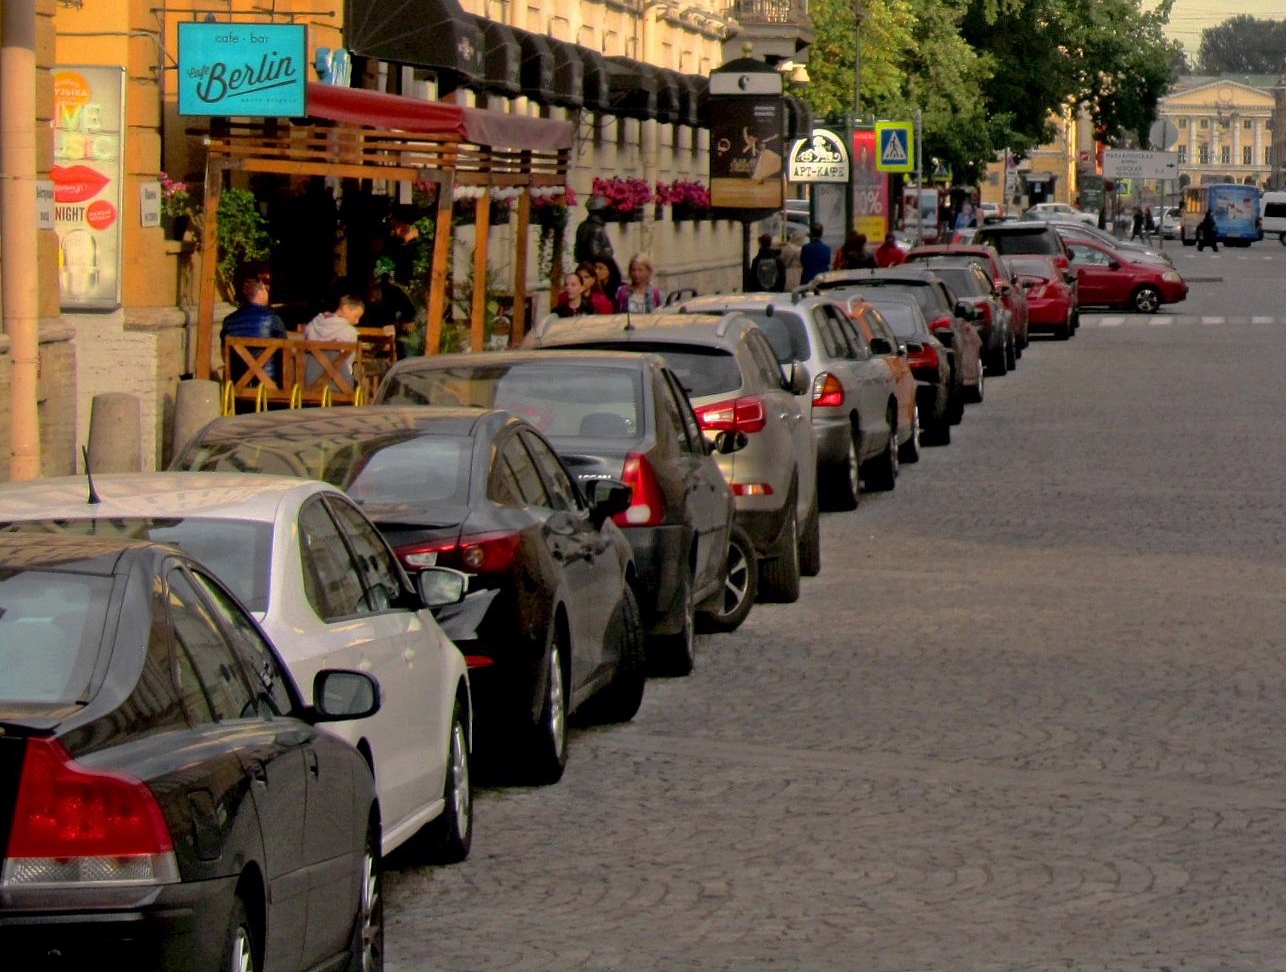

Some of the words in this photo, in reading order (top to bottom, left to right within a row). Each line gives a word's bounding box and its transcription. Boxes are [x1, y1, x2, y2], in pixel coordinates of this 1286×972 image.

[214, 31, 239, 44] cafe
[250, 32, 270, 44] bar
[196, 51, 297, 104] Berlin
[793, 166, 845, 178] АРТ-КАФЕ
[55, 206, 86, 222] NIGHT
